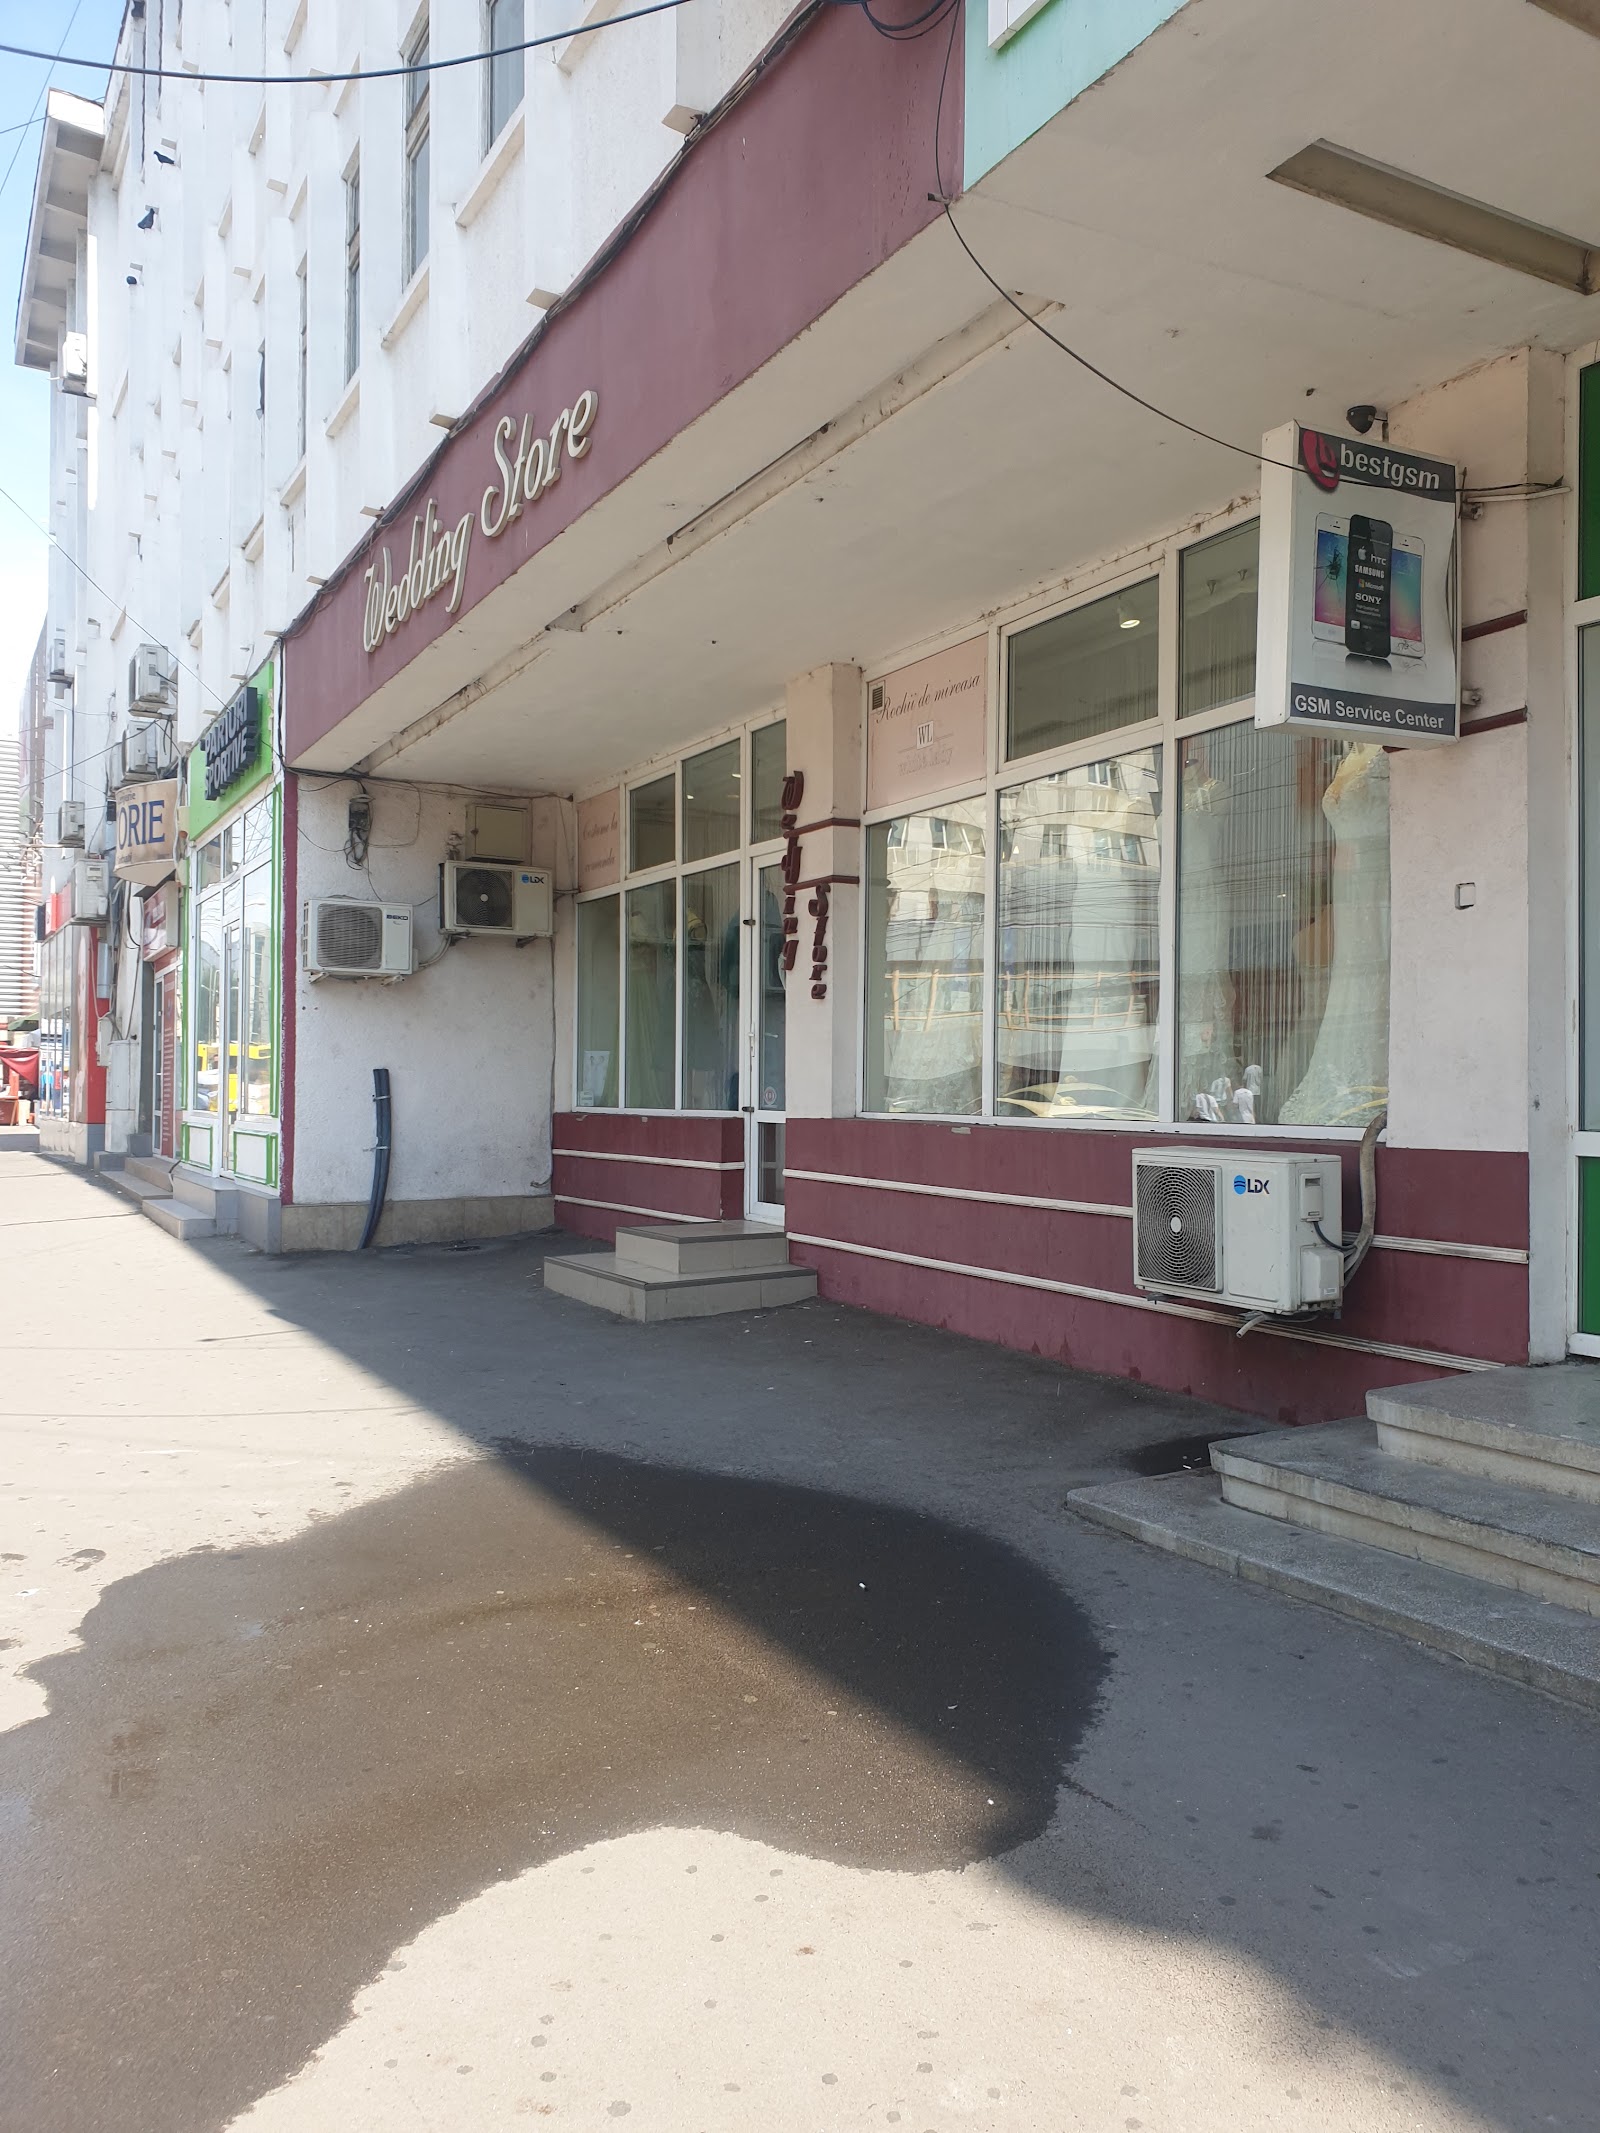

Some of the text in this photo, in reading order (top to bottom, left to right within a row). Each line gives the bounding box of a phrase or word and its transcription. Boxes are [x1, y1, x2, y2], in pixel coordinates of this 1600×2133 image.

[1339, 443, 1440, 490] bestgsm
[363, 390, 599, 652] Wedding Store
[1355, 565, 1384, 578] SAMSUNG
[1365, 582, 1384, 590] Microsoft
[1355, 592, 1382, 605] SONY
[876, 674, 981, 724] Rochii de mireasa
[1295, 693, 1444, 729] GSM Service Center
[202, 687, 257, 765] PARIURI
[918, 723, 933, 745] WL
[205, 727, 256, 801] SPORTIVE
[808, 882, 831, 999] Store
